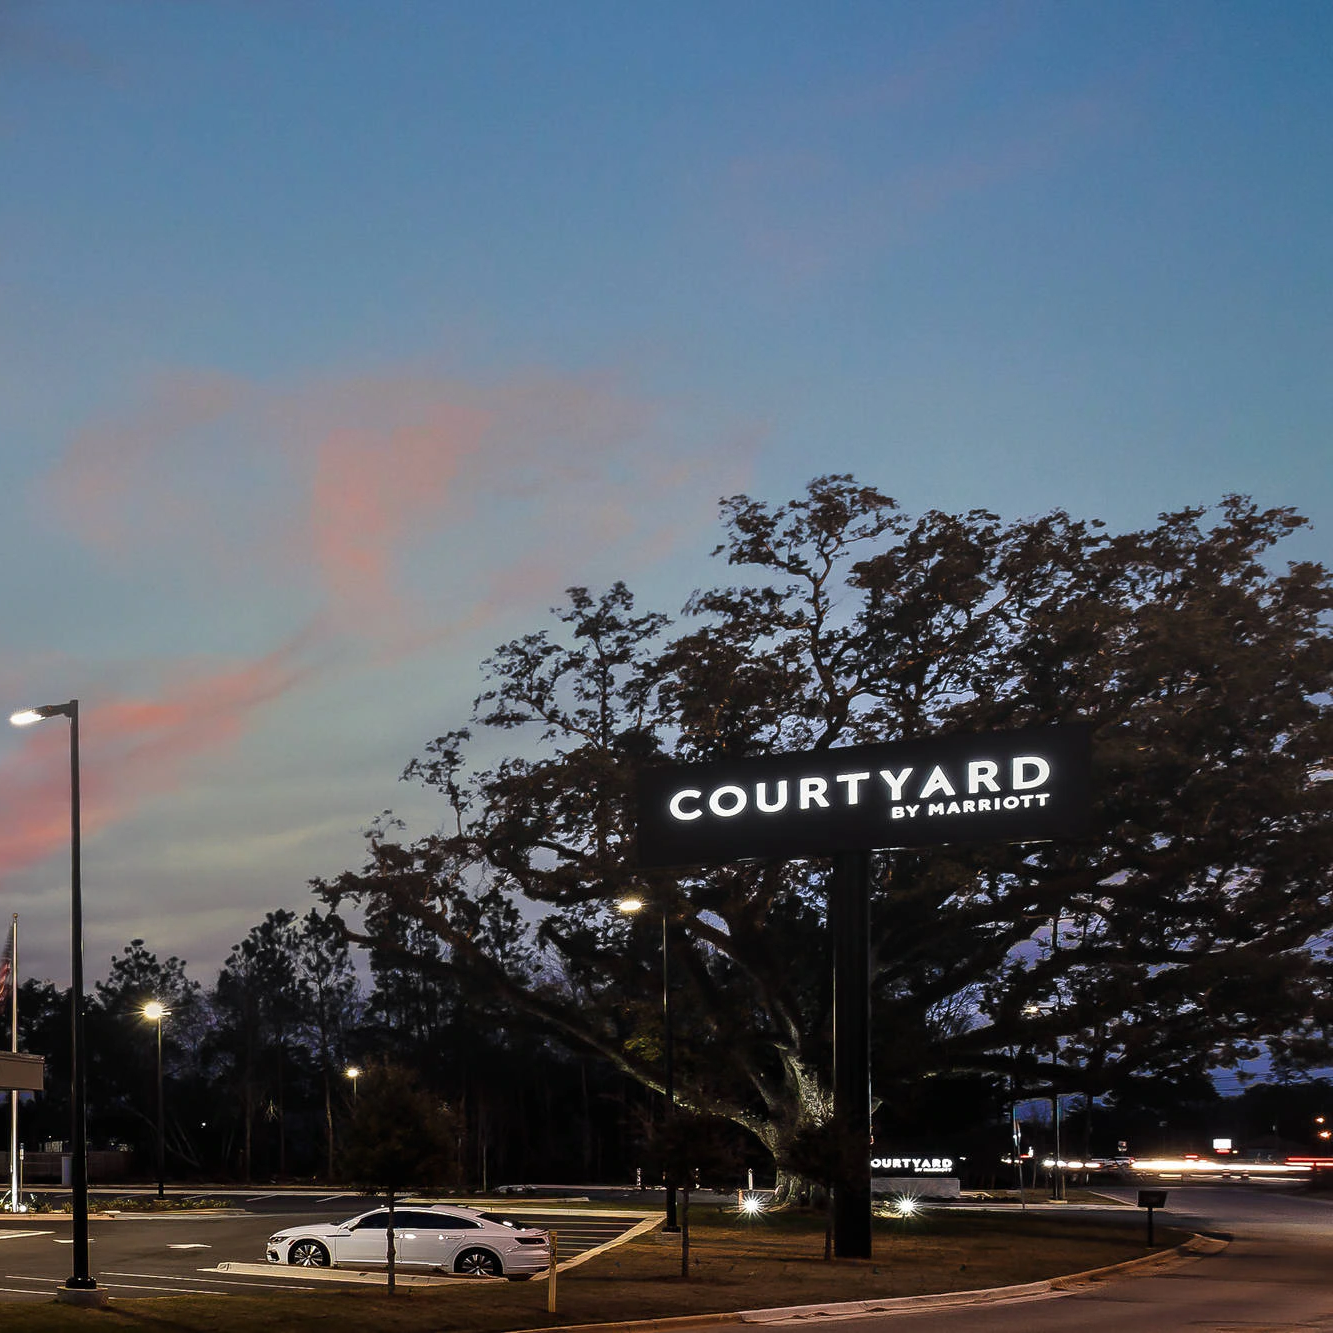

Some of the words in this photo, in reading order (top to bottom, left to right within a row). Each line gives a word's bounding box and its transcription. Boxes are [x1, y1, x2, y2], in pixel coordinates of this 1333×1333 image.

[669, 756, 1050, 821] COURTYARD
[891, 804, 920, 819] BY
[928, 793, 1051, 817] MARRIOTT
[870, 1158, 953, 1168] OURTYARD
